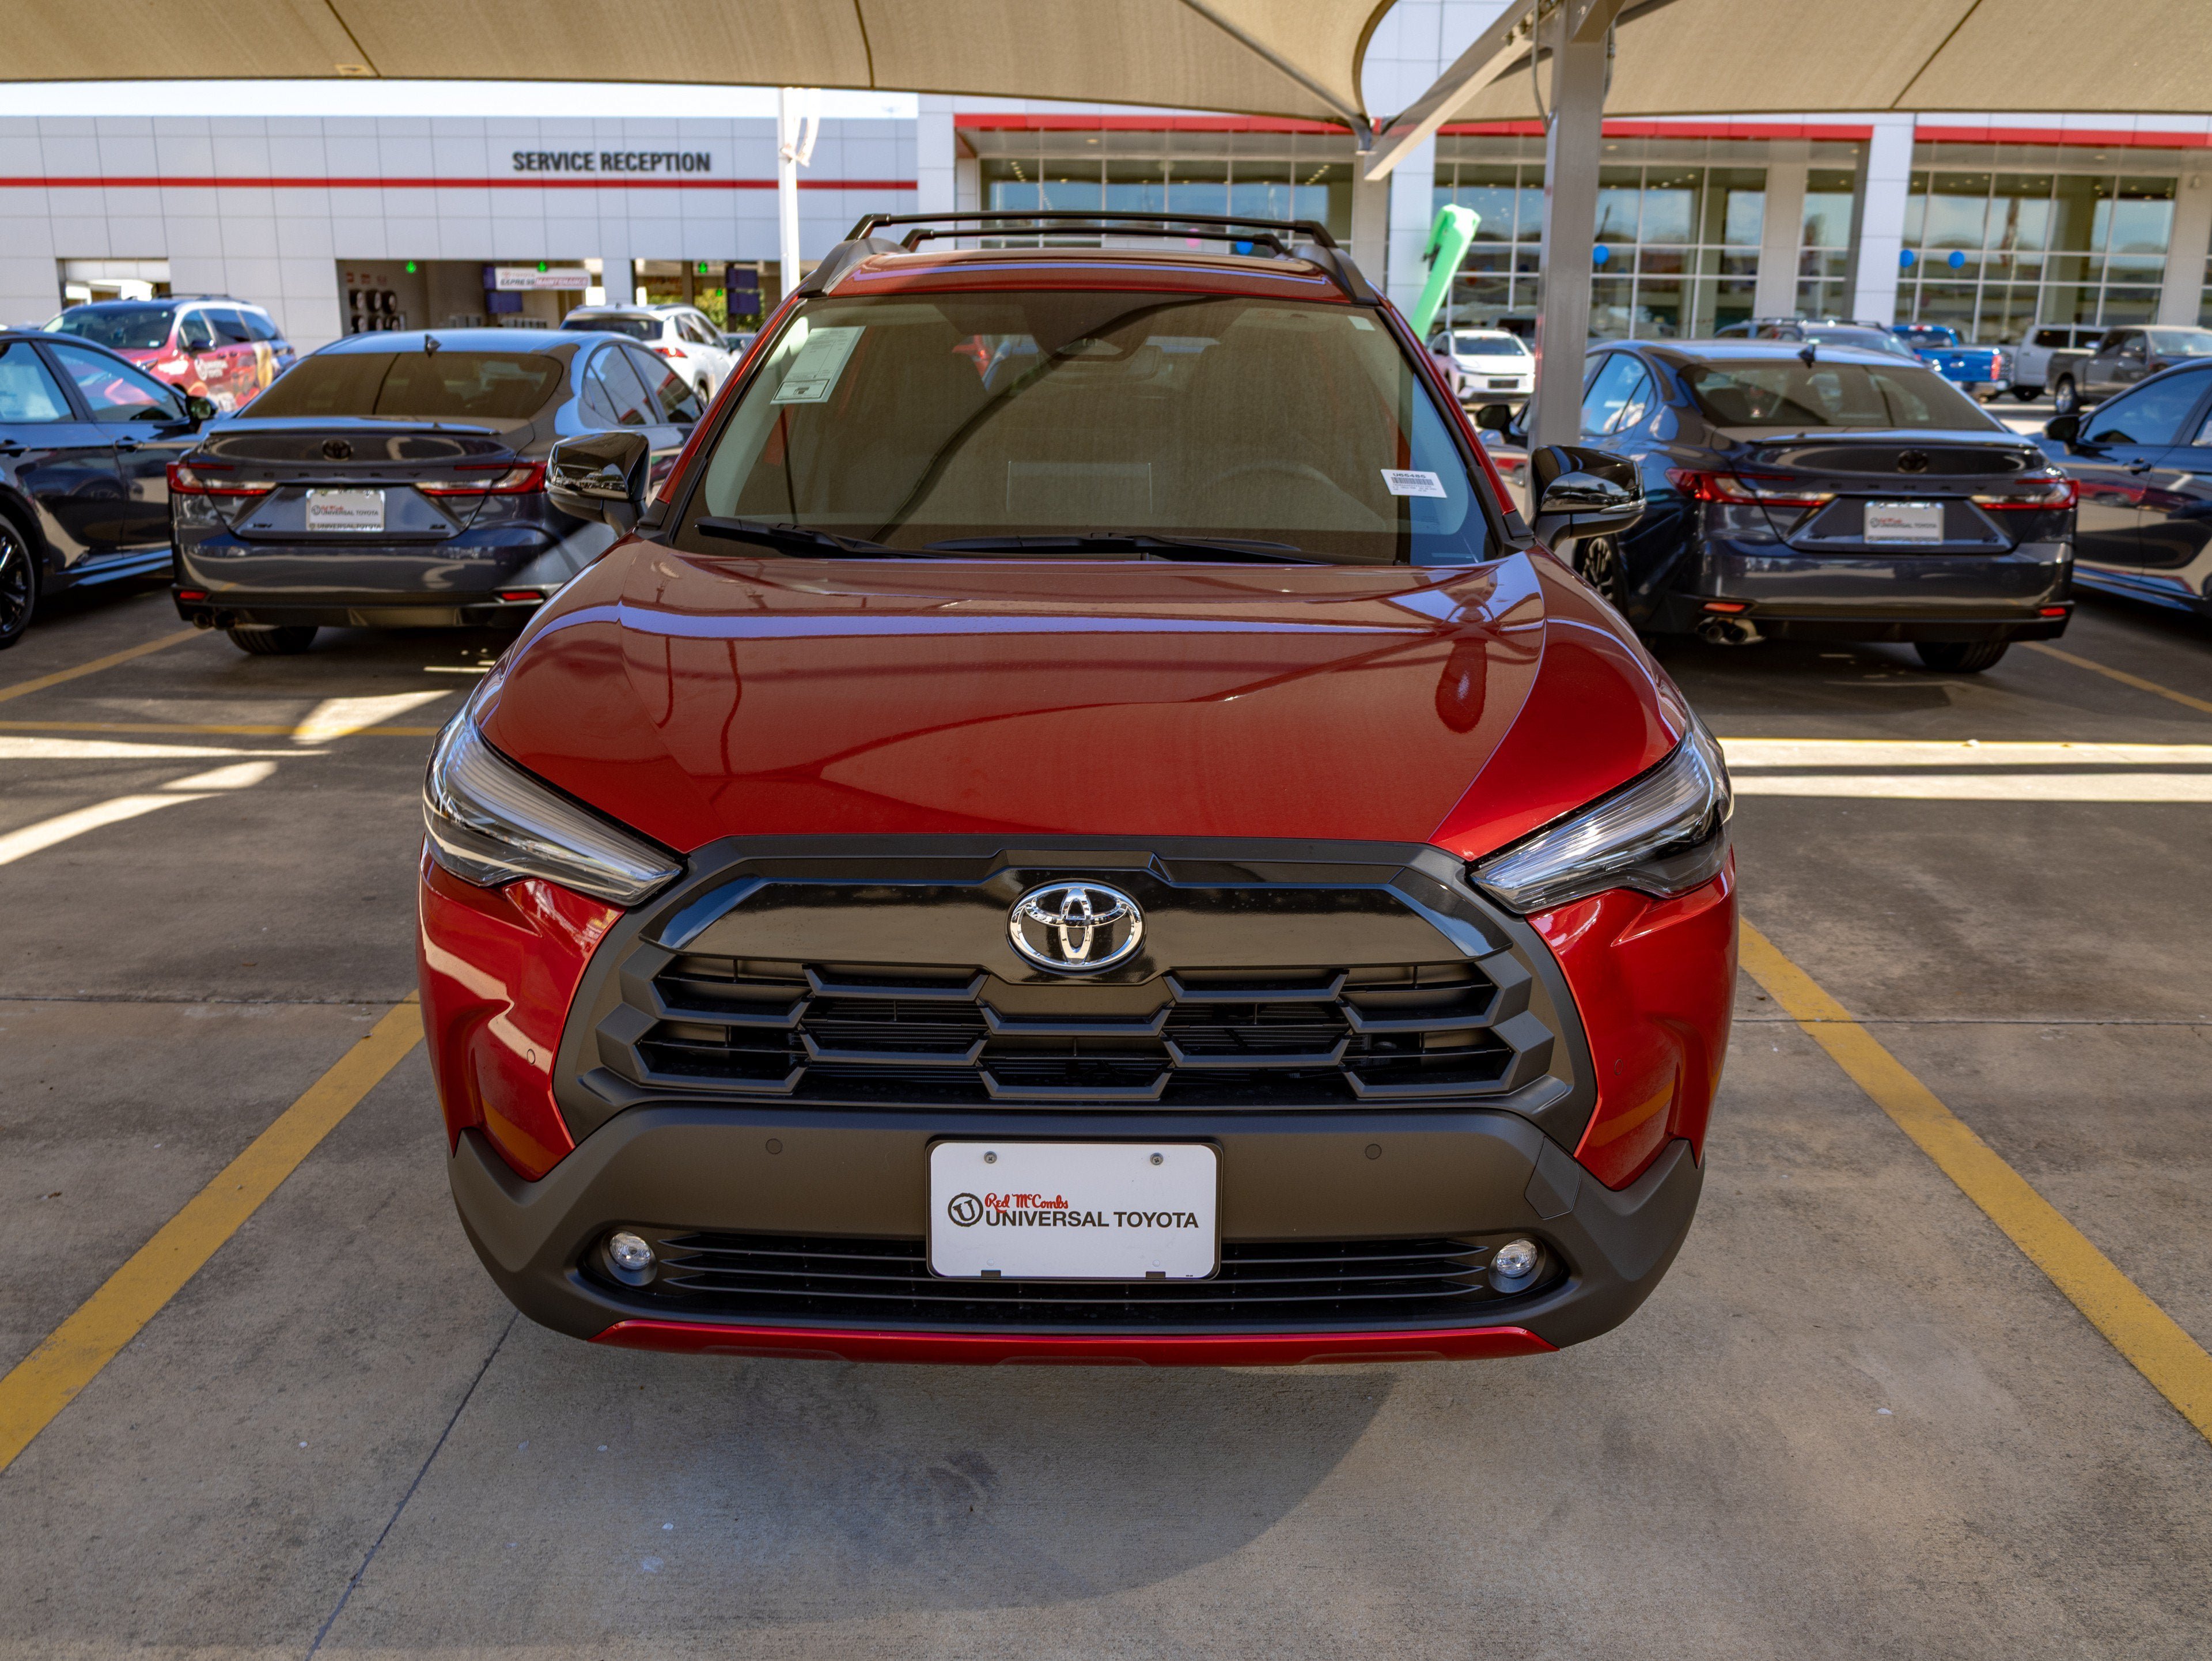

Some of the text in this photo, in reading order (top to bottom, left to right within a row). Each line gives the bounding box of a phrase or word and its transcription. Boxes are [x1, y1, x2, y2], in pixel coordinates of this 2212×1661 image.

[513, 152, 711, 172] SERVICE RECEPTION
[984, 1193, 1069, 1214] Red McCombs
[986, 1210, 1199, 1228] UNIVERSAL TOYOTA
